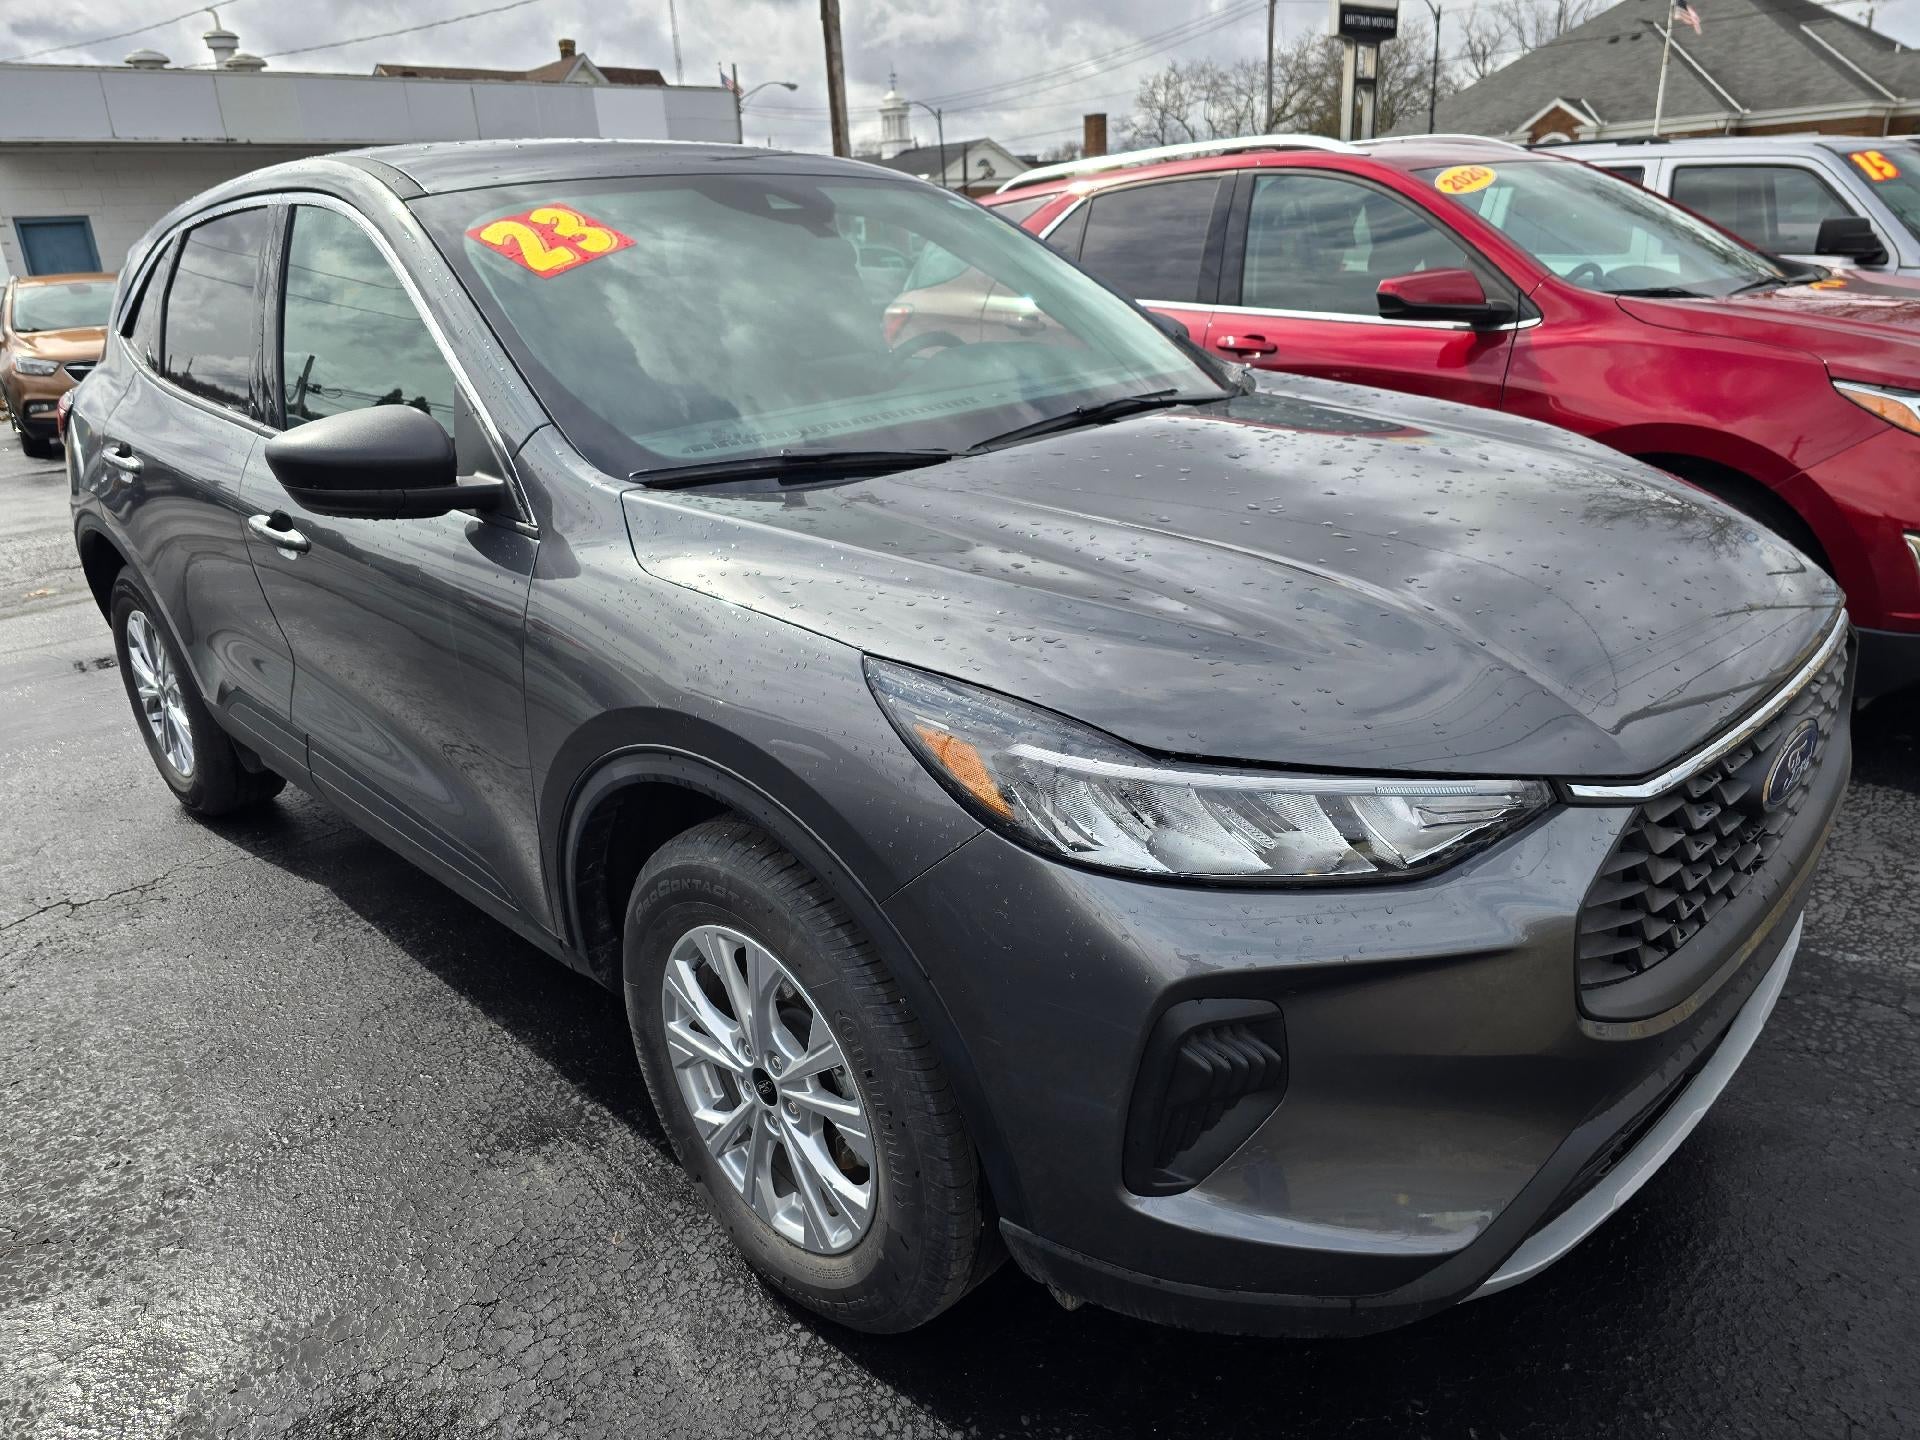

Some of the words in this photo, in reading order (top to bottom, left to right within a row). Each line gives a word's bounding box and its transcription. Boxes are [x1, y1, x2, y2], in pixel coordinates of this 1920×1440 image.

[1371, 16, 1396, 29] MOTORS
[1442, 167, 1489, 191] 2020
[1850, 149, 1898, 181] 15
[479, 207, 619, 272] 23
[1783, 738, 1814, 791] Ford
